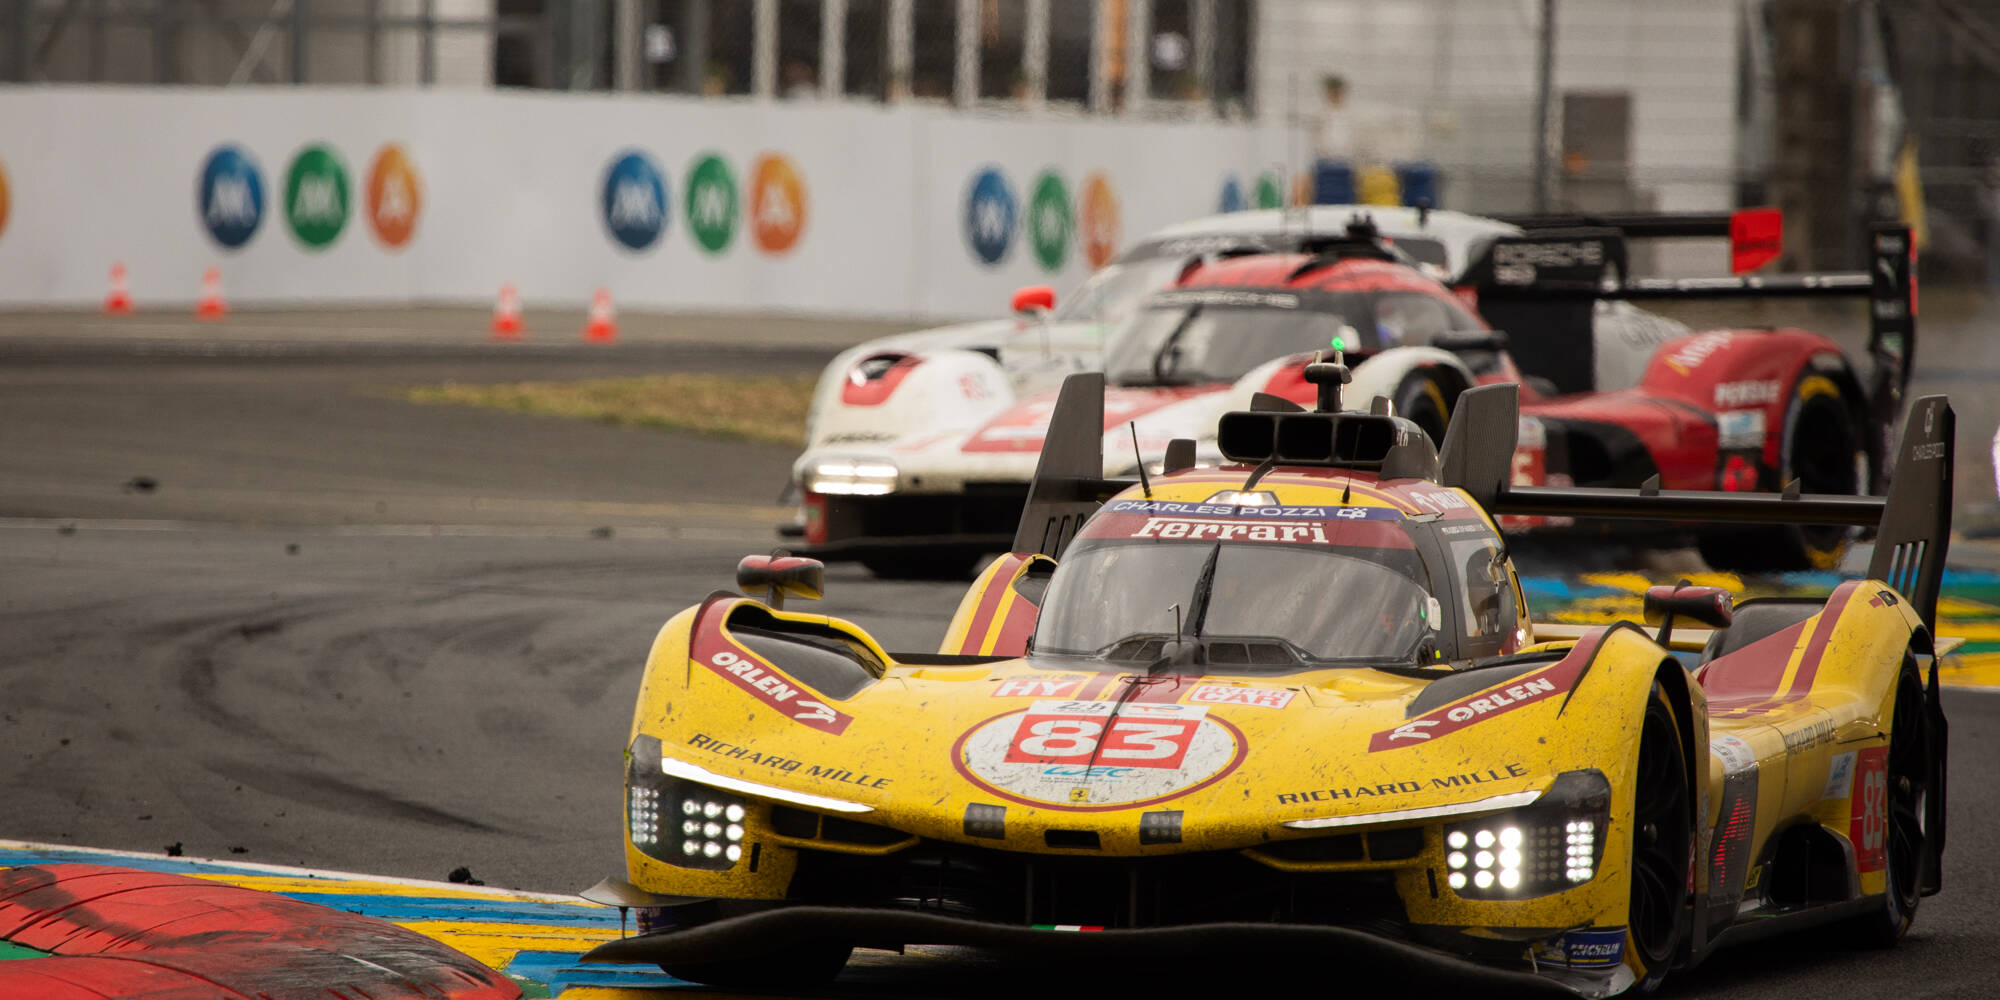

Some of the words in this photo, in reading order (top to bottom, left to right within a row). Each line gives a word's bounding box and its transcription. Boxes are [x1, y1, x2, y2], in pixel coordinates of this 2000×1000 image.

[1112, 500, 1234, 516] CHARLES
[1239, 504, 1325, 517] POZZI
[1131, 516, 1330, 543] Ferrari
[712, 651, 798, 702] ORLEN
[994, 680, 1078, 697] HY
[1197, 691, 1282, 706] CAR
[1447, 677, 1556, 722] ORLEN
[1018, 719, 1185, 760] 83
[687, 733, 803, 772] RICHARD
[805, 764, 894, 790] MILLE
[1043, 767, 1134, 778] WEC
[1277, 781, 1421, 805] RICHARD
[1431, 762, 1528, 789] MILLE
[1863, 770, 1884, 850] 83
